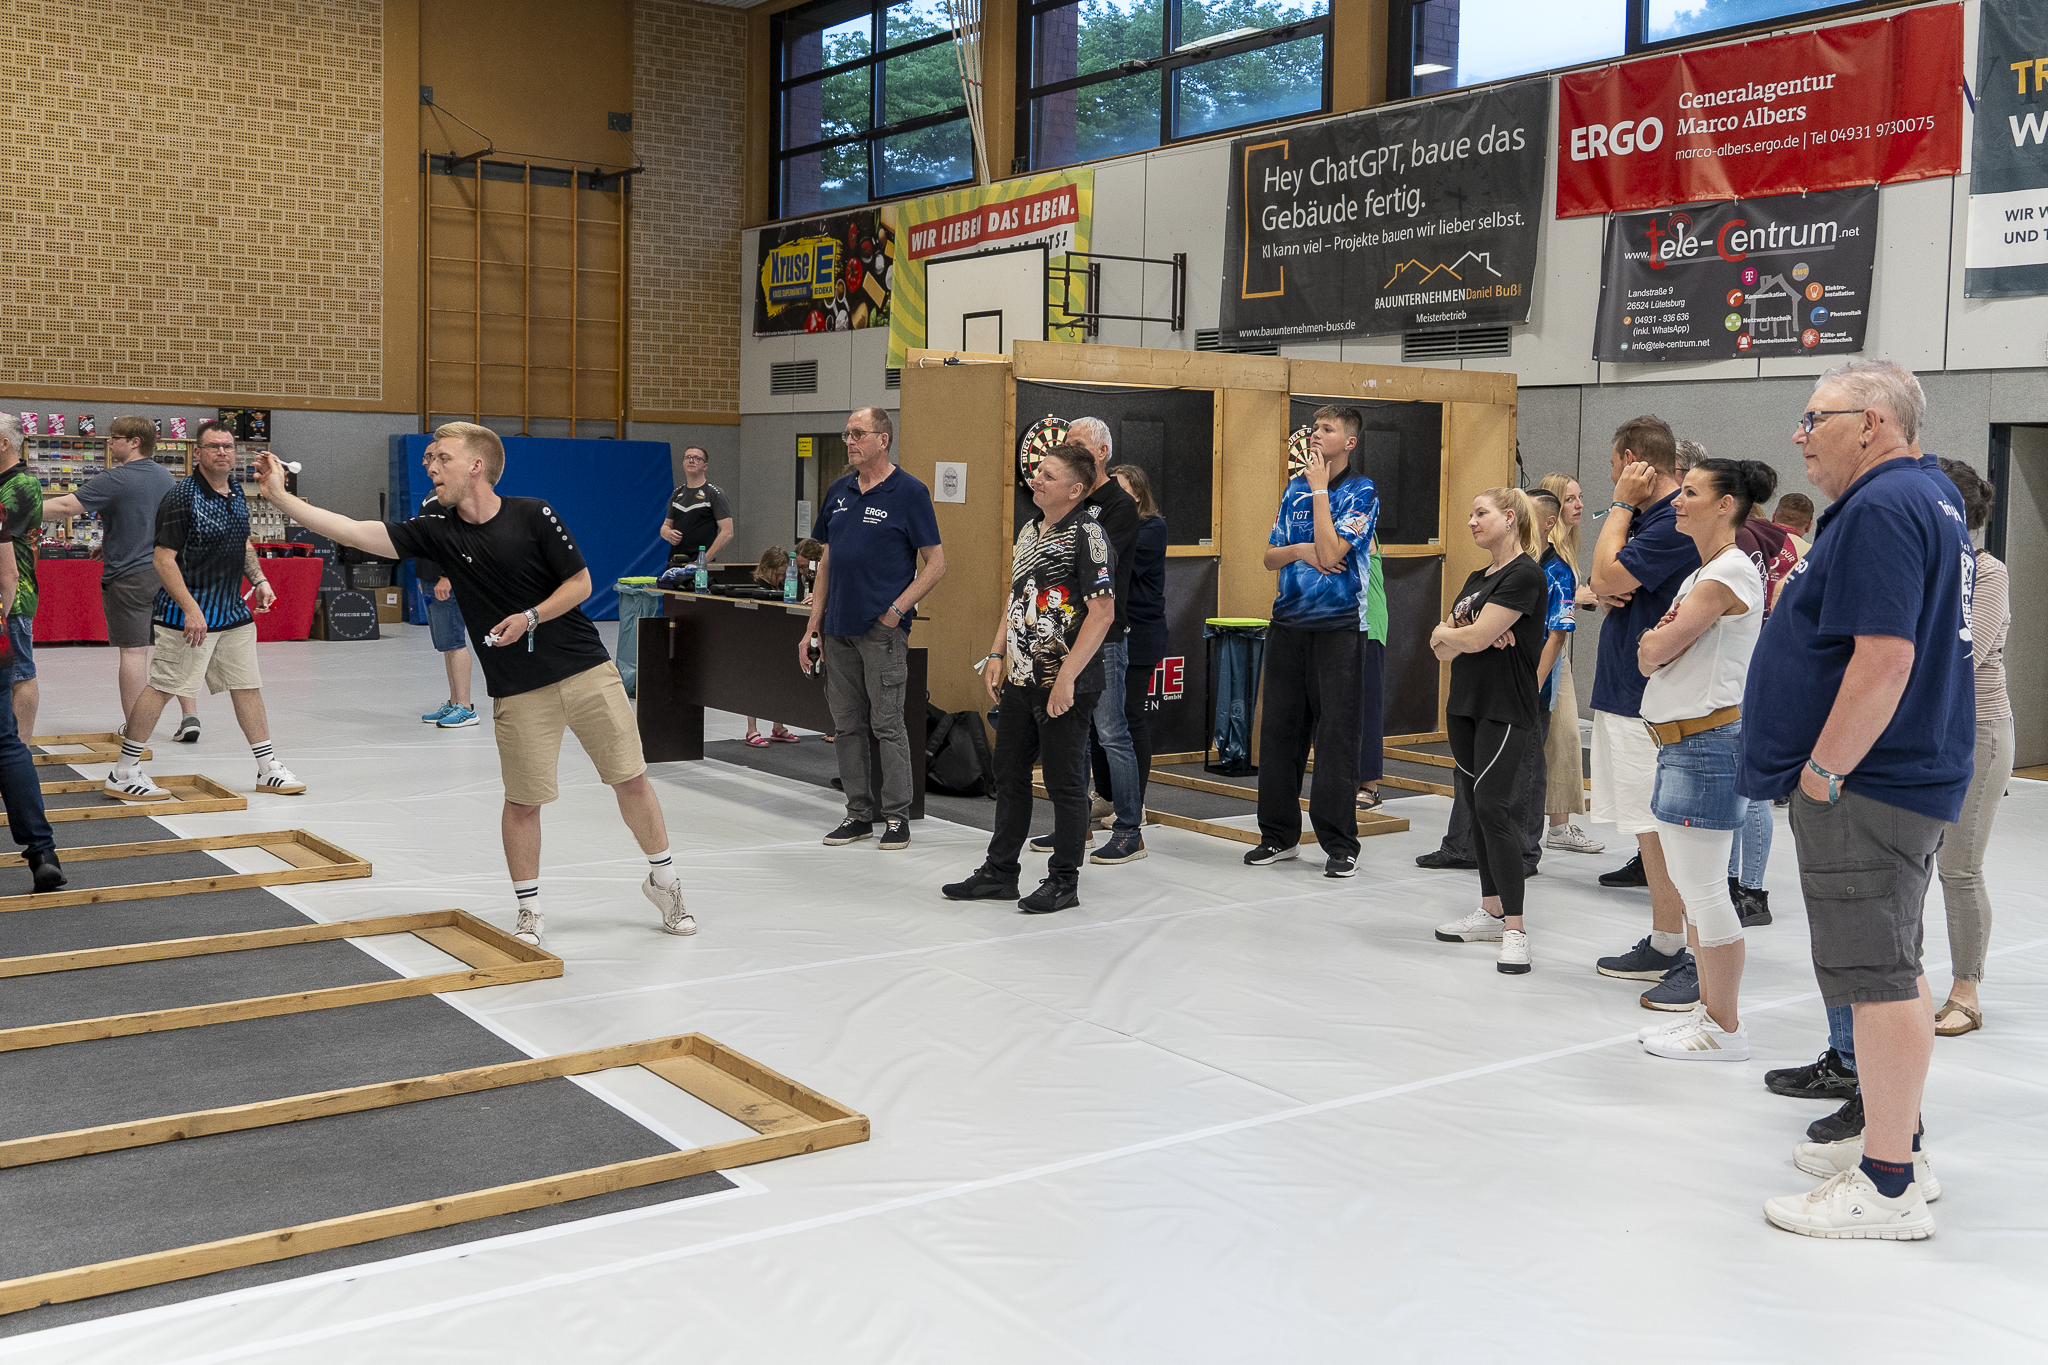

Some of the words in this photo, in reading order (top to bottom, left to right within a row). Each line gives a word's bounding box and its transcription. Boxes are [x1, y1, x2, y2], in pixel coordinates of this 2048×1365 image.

[1678, 72, 1836, 110] Generalagentur
[1677, 114, 1740, 136] Marco
[1743, 103, 1807, 128] Albers
[1570, 116, 1664, 162] ERGO
[1675, 135, 1800, 161] marco-albers.ergo.de
[1810, 129, 1828, 146] Tel
[1829, 126, 1871, 144] 04931
[1875, 115, 1935, 139] 9730075
[1264, 167, 1303, 197] Hey
[1310, 143, 1405, 187] ChatGPT,
[1411, 137, 1471, 168] baue
[1478, 124, 1526, 155] das
[1262, 194, 1358, 231] Gebäude
[1364, 185, 1427, 223] fertig.
[2005, 207, 2034, 222] WIR
[911, 228, 937, 252] WIR
[987, 207, 1019, 233] DAS
[1024, 194, 1076, 226] LEBEN.
[1262, 244, 1271, 259] KI
[1273, 242, 1300, 257] kann
[1303, 237, 1322, 253] viel
[1334, 230, 1379, 252] Projekte
[1382, 227, 1414, 244] bauen
[1416, 222, 1436, 237] wir
[1439, 215, 1475, 234] lieber
[1478, 211, 1526, 230] selbst.
[2004, 229, 2039, 244] UND
[771, 250, 810, 284] Kruse
[814, 285, 833, 295] EDEKA
[1374, 288, 1466, 310] BAUUNTERNEHMEN
[1466, 285, 1493, 301] Daniel
[1495, 283, 1518, 297] Buß
[1628, 287, 1667, 298] Landstraße
[1668, 286, 1674, 295] 9
[1744, 291, 1787, 300] Kommunikation
[1626, 301, 1649, 311] 26524
[1650, 299, 1686, 310] Lütetsburg
[1415, 310, 1467, 324] Meisterbetrieb
[1634, 315, 1657, 325] 04931
[1662, 313, 1676, 322] 936
[1676, 312, 1690, 321] 636
[1742, 314, 1792, 324] Netzwerktechnik
[1239, 319, 1356, 338] www.bauunternehmen-buss.de
[1632, 326, 1650, 337] (inkl.
[1652, 324, 1690, 335] WhatsApp)
[1631, 338, 1710, 352] info@tele-centrum.net
[864, 506, 888, 519] ERGO
[1292, 510, 1311, 520] TGT
[1780, 547, 1796, 563] OUR
